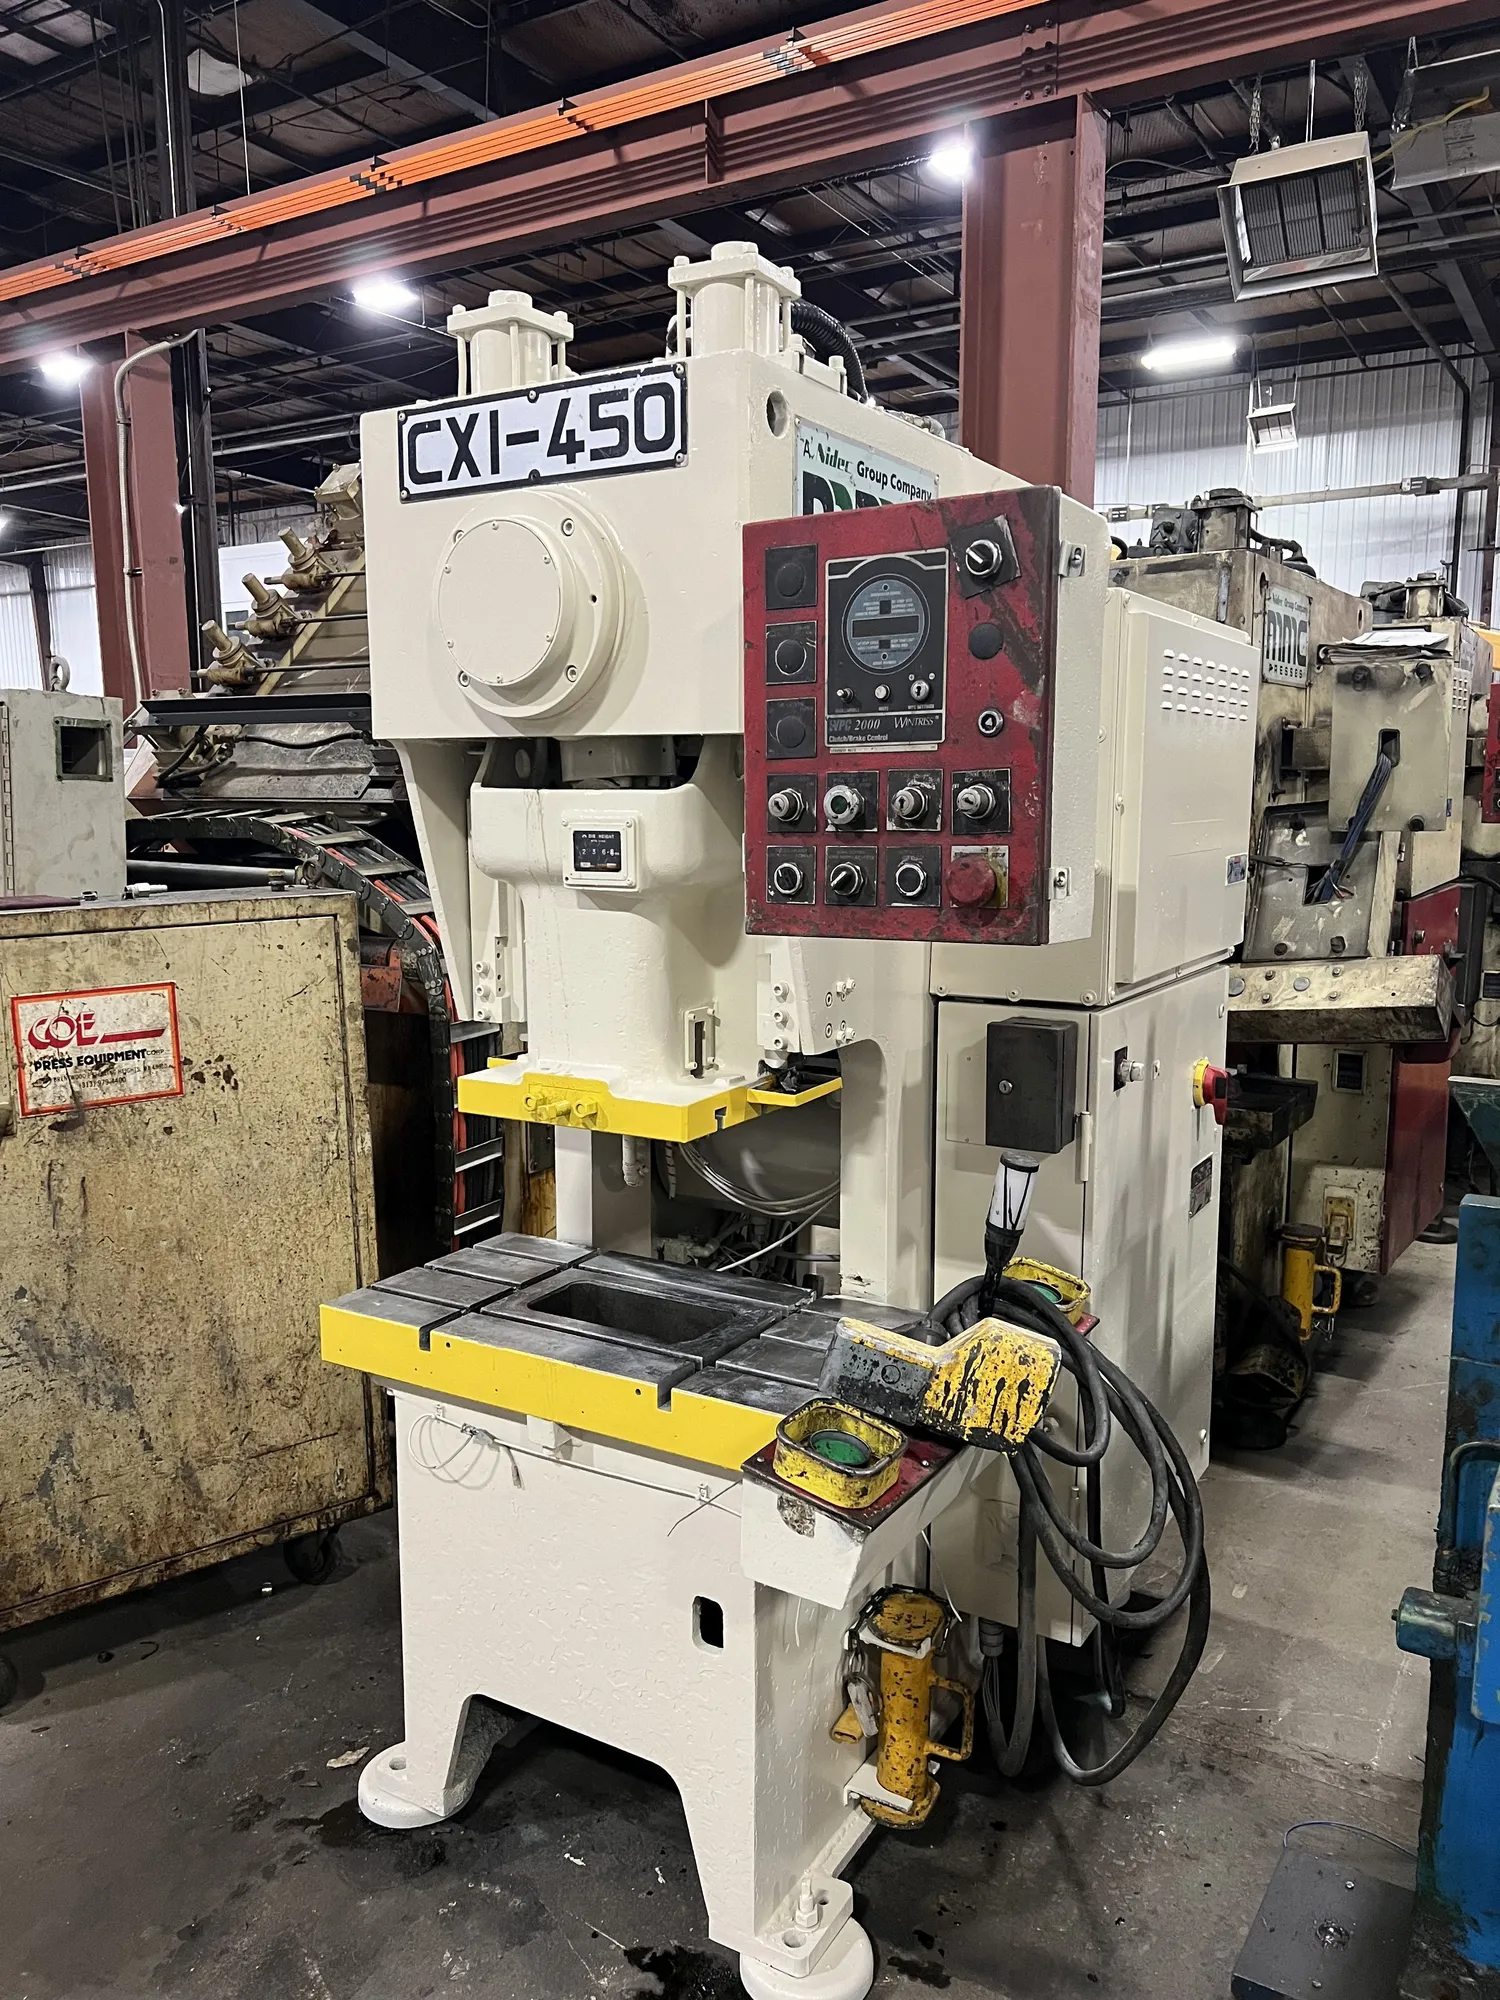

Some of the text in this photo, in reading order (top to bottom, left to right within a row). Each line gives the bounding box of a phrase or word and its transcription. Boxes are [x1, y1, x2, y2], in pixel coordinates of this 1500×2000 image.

[857, 460, 888, 489] Group
[890, 473, 932, 500] Company
[854, 719, 880, 731] 2000
[28, 1011, 99, 1050] COE
[34, 1056, 73, 1072] PRESS
[77, 1049, 147, 1067] EQUIPMENT
